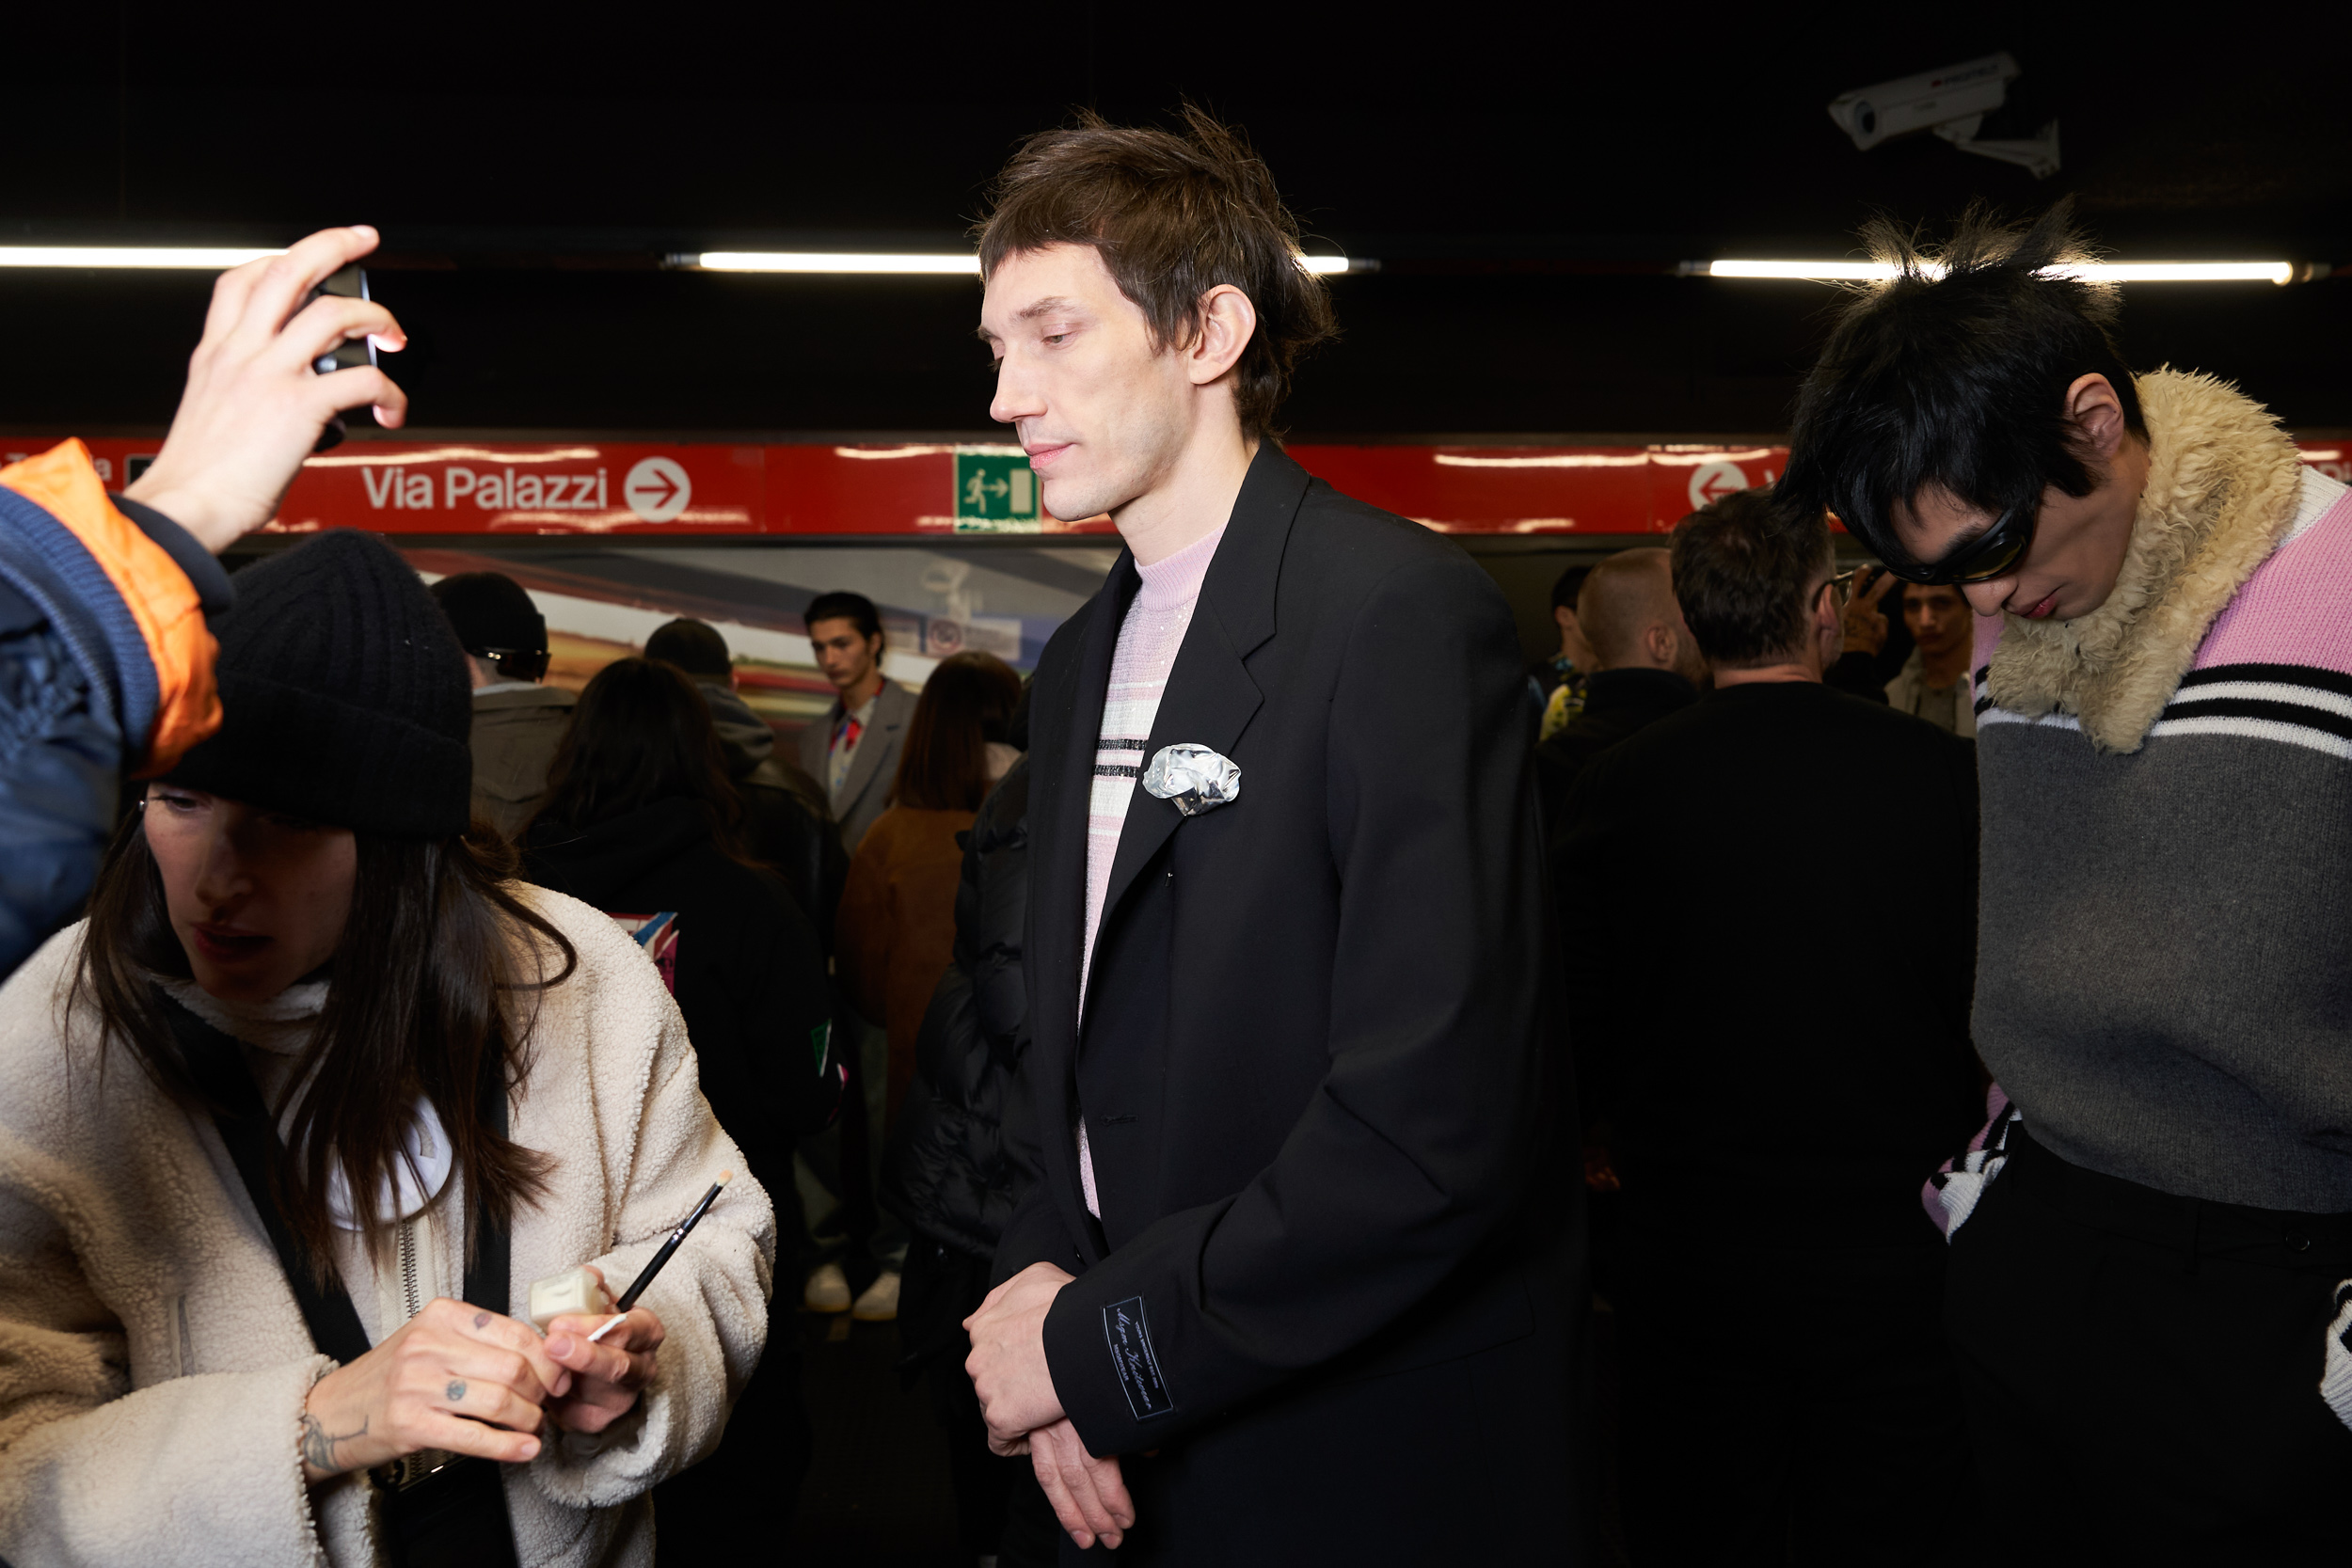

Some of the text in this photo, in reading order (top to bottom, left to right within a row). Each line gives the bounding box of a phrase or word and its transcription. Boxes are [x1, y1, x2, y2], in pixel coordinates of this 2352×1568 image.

[361, 467, 608, 509] Via Palazzi
[1125, 1347, 1152, 1410] Knitwear
